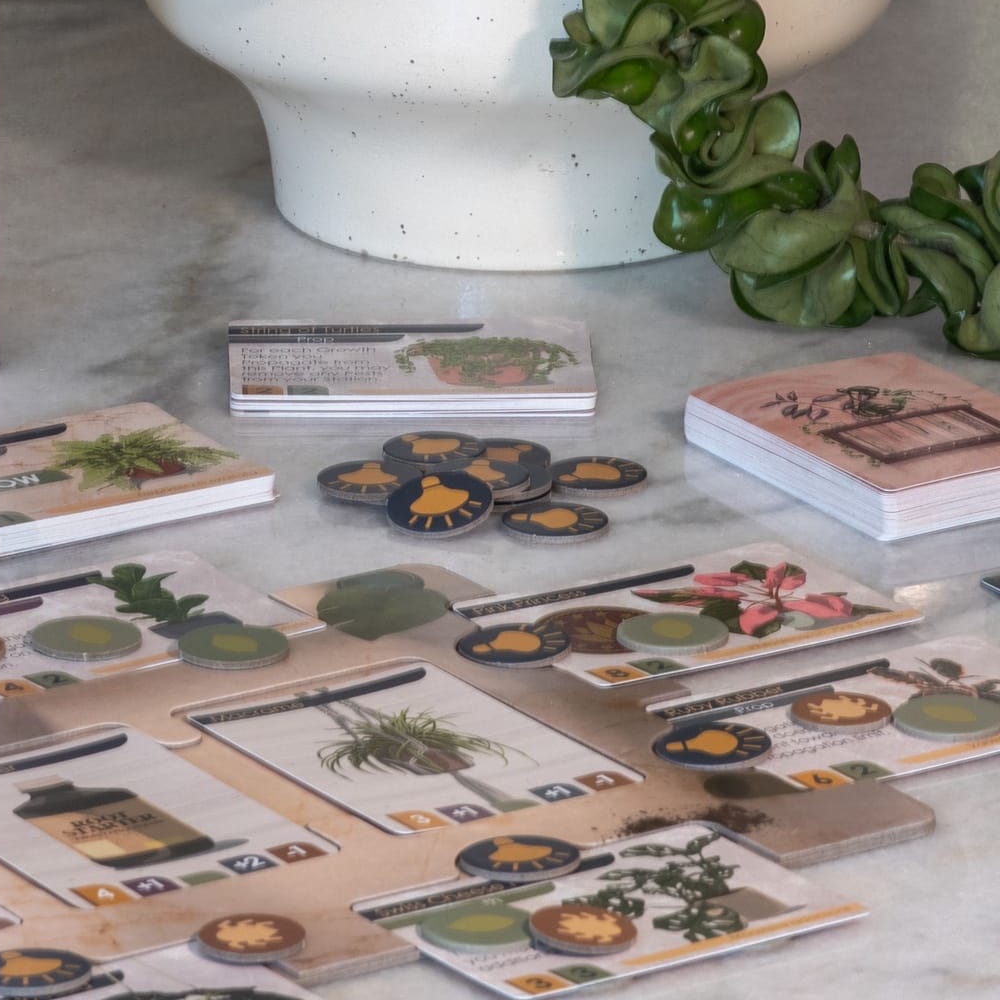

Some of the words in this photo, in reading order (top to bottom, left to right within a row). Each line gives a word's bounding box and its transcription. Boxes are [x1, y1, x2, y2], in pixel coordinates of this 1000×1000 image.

[297, 336, 335, 344] Prop
[663, 700, 713, 718] Ruby
[714, 685, 785, 706] Rubber
[733, 701, 775, 716] Prop
